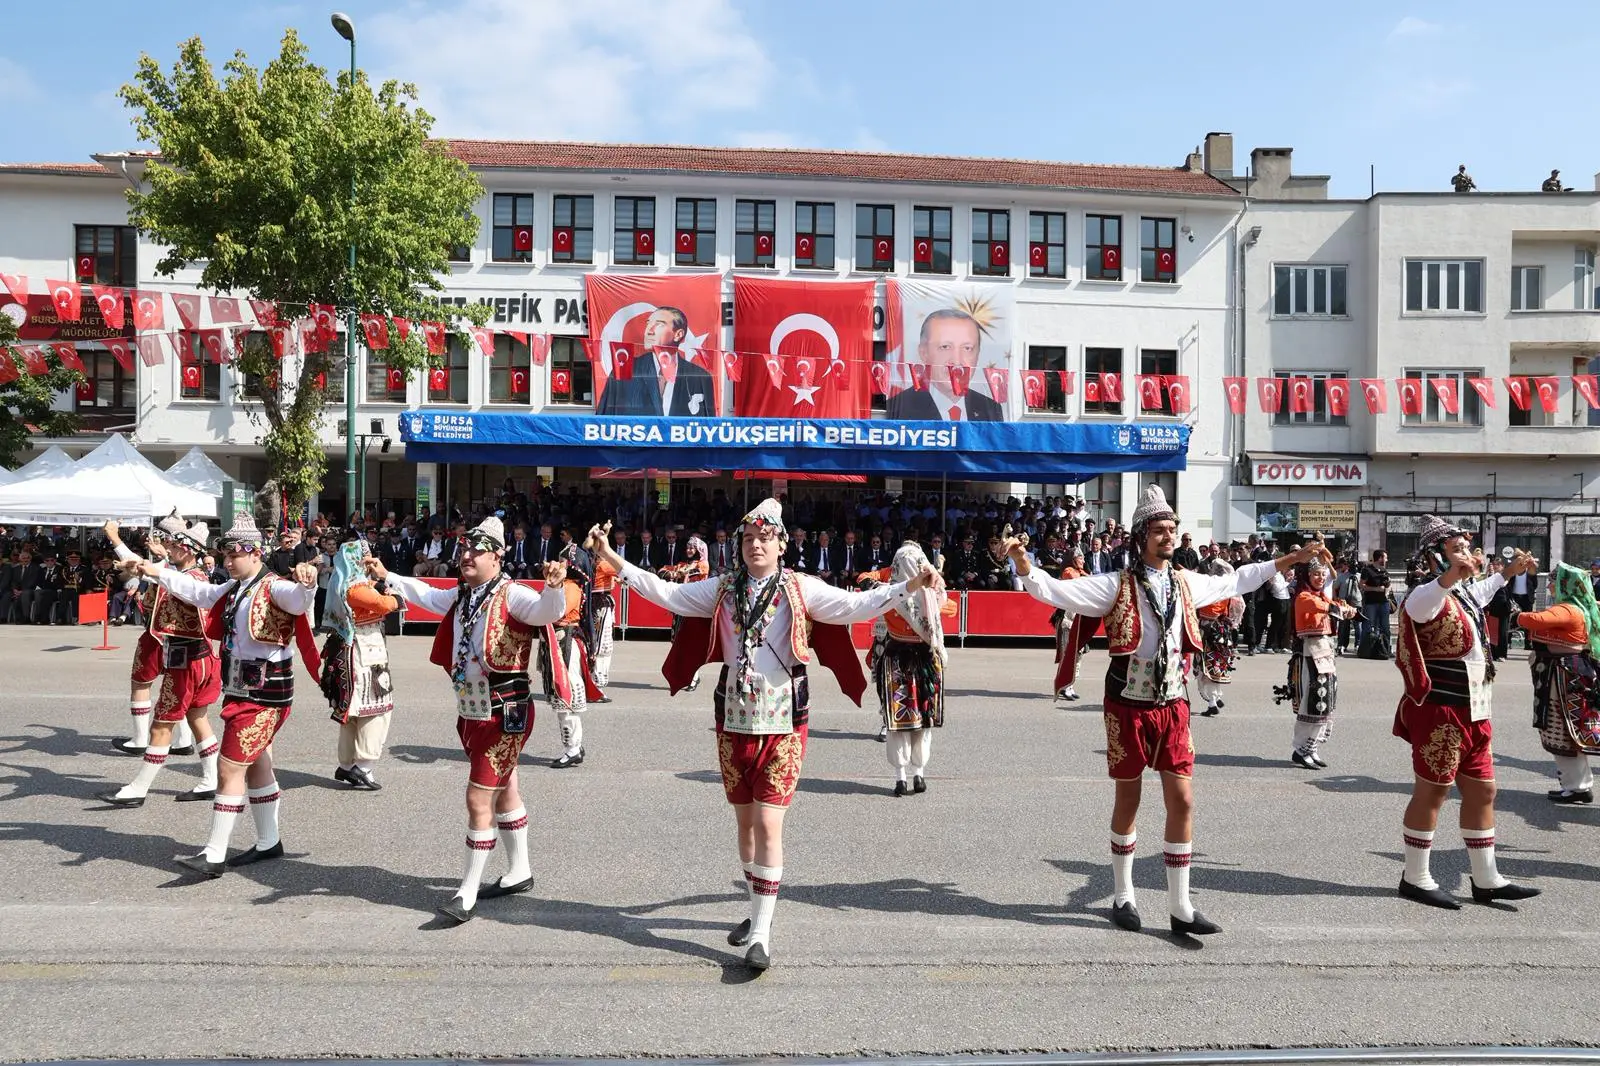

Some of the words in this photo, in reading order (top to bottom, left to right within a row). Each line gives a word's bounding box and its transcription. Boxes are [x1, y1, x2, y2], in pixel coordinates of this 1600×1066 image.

[434, 415, 473, 425] BURSA
[433, 424, 473, 432] BÜYÜKŞEHİR
[1141, 427, 1179, 437] BURSA
[433, 431, 473, 439] BELEDİYESİ
[584, 424, 663, 442] BURSA
[670, 421, 818, 445] BÜYÜKŞEHİR
[825, 425, 957, 447] BELEDİYESİ
[1257, 464, 1306, 480] FOTO
[1312, 464, 1362, 480] TUNA
